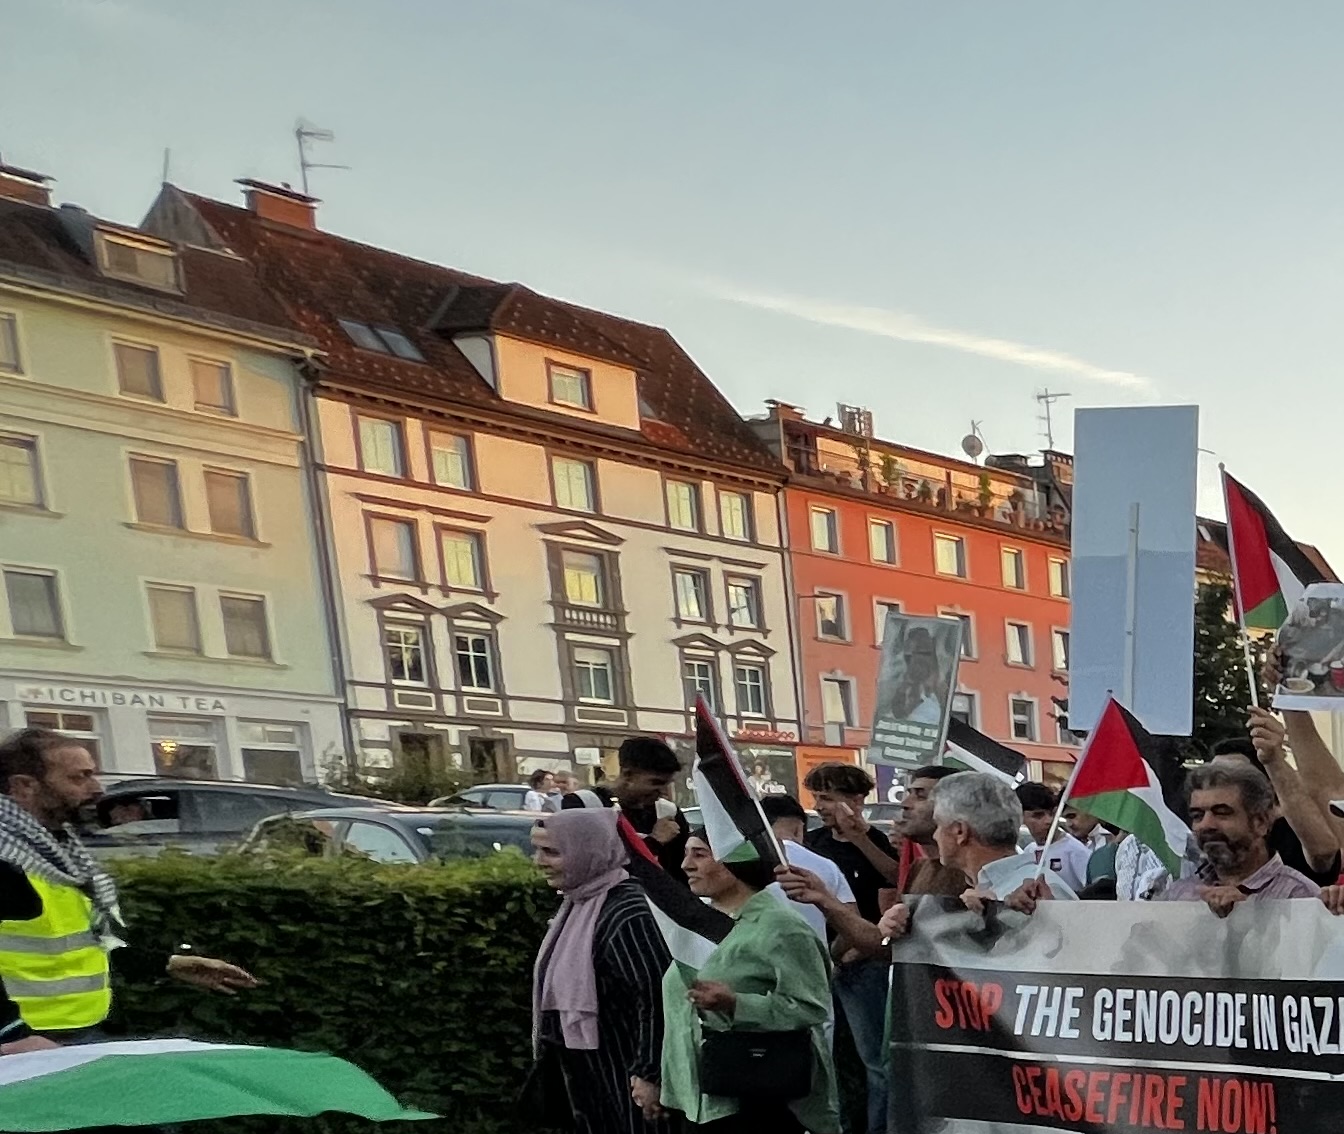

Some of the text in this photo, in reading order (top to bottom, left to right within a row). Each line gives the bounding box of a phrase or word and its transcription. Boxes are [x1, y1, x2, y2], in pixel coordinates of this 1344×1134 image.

[49, 688, 227, 711] ICHIBAN TEA
[933, 978, 1004, 1032] STOP
[1012, 984, 1085, 1040] THE
[1091, 988, 1248, 1050] GENOCIDE
[1252, 993, 1280, 1052] IN
[1011, 1064, 1187, 1131] CEASEFIRE
